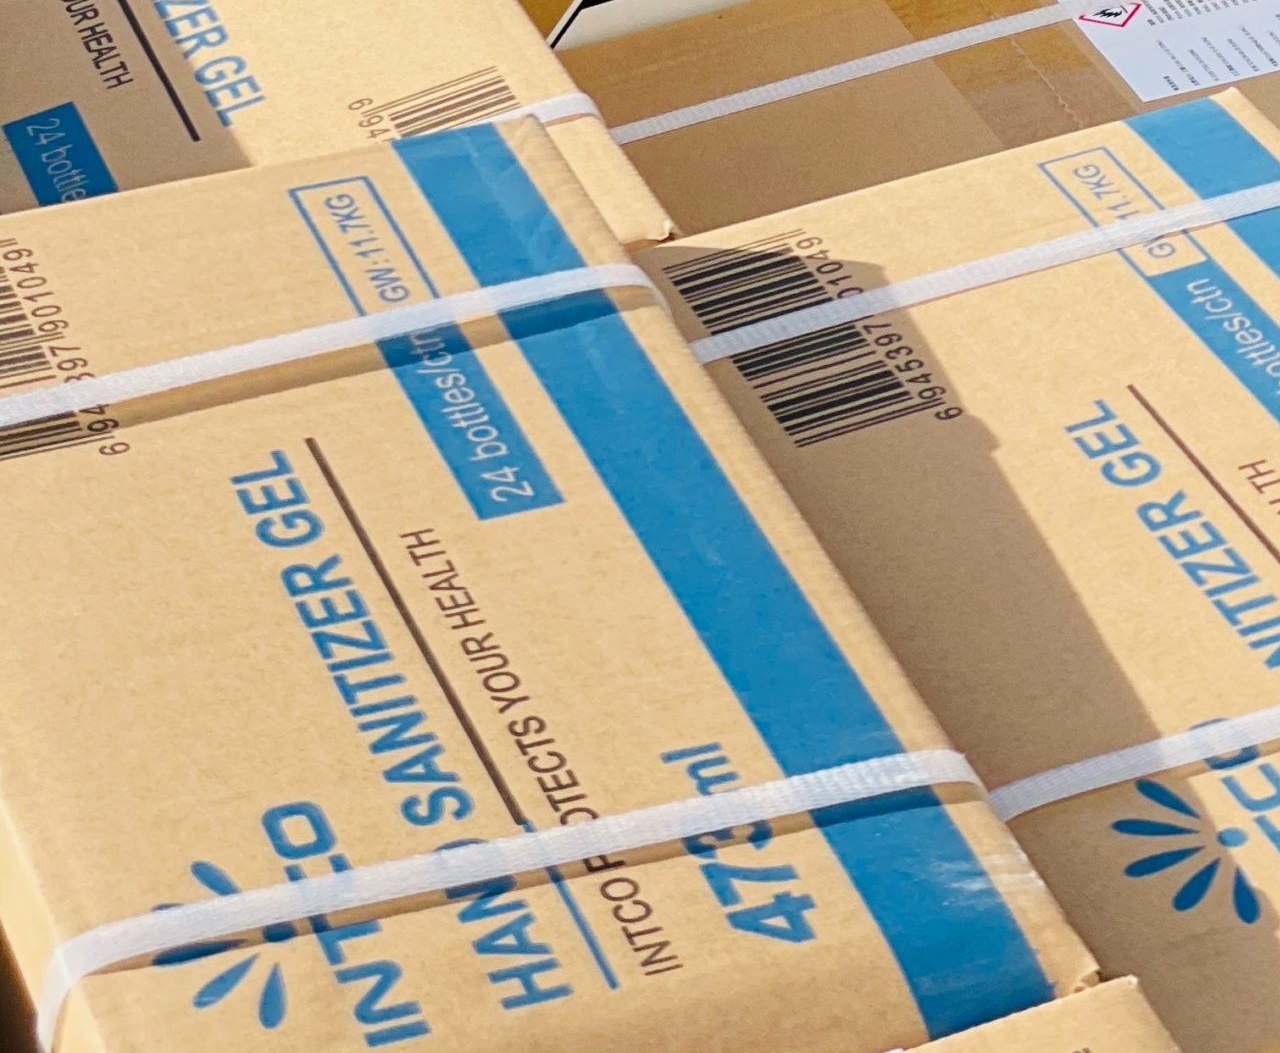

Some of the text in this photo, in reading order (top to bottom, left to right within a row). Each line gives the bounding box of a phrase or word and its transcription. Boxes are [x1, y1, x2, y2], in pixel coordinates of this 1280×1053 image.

[77, 22, 134, 90] HEALTH
[193, 54, 266, 127] GEL
[26, 117, 67, 146] 24
[408, 325, 535, 503] 24 bottles/ctn
[1063, 399, 1162, 488] GEL
[400, 528, 487, 631] HEALTH
[460, 631, 530, 714] YOUR
[229, 449, 575, 1011] HAN SANITIZER GEL
[261, 800, 432, 1047] INTO
[599, 875, 683, 976] INTCO
